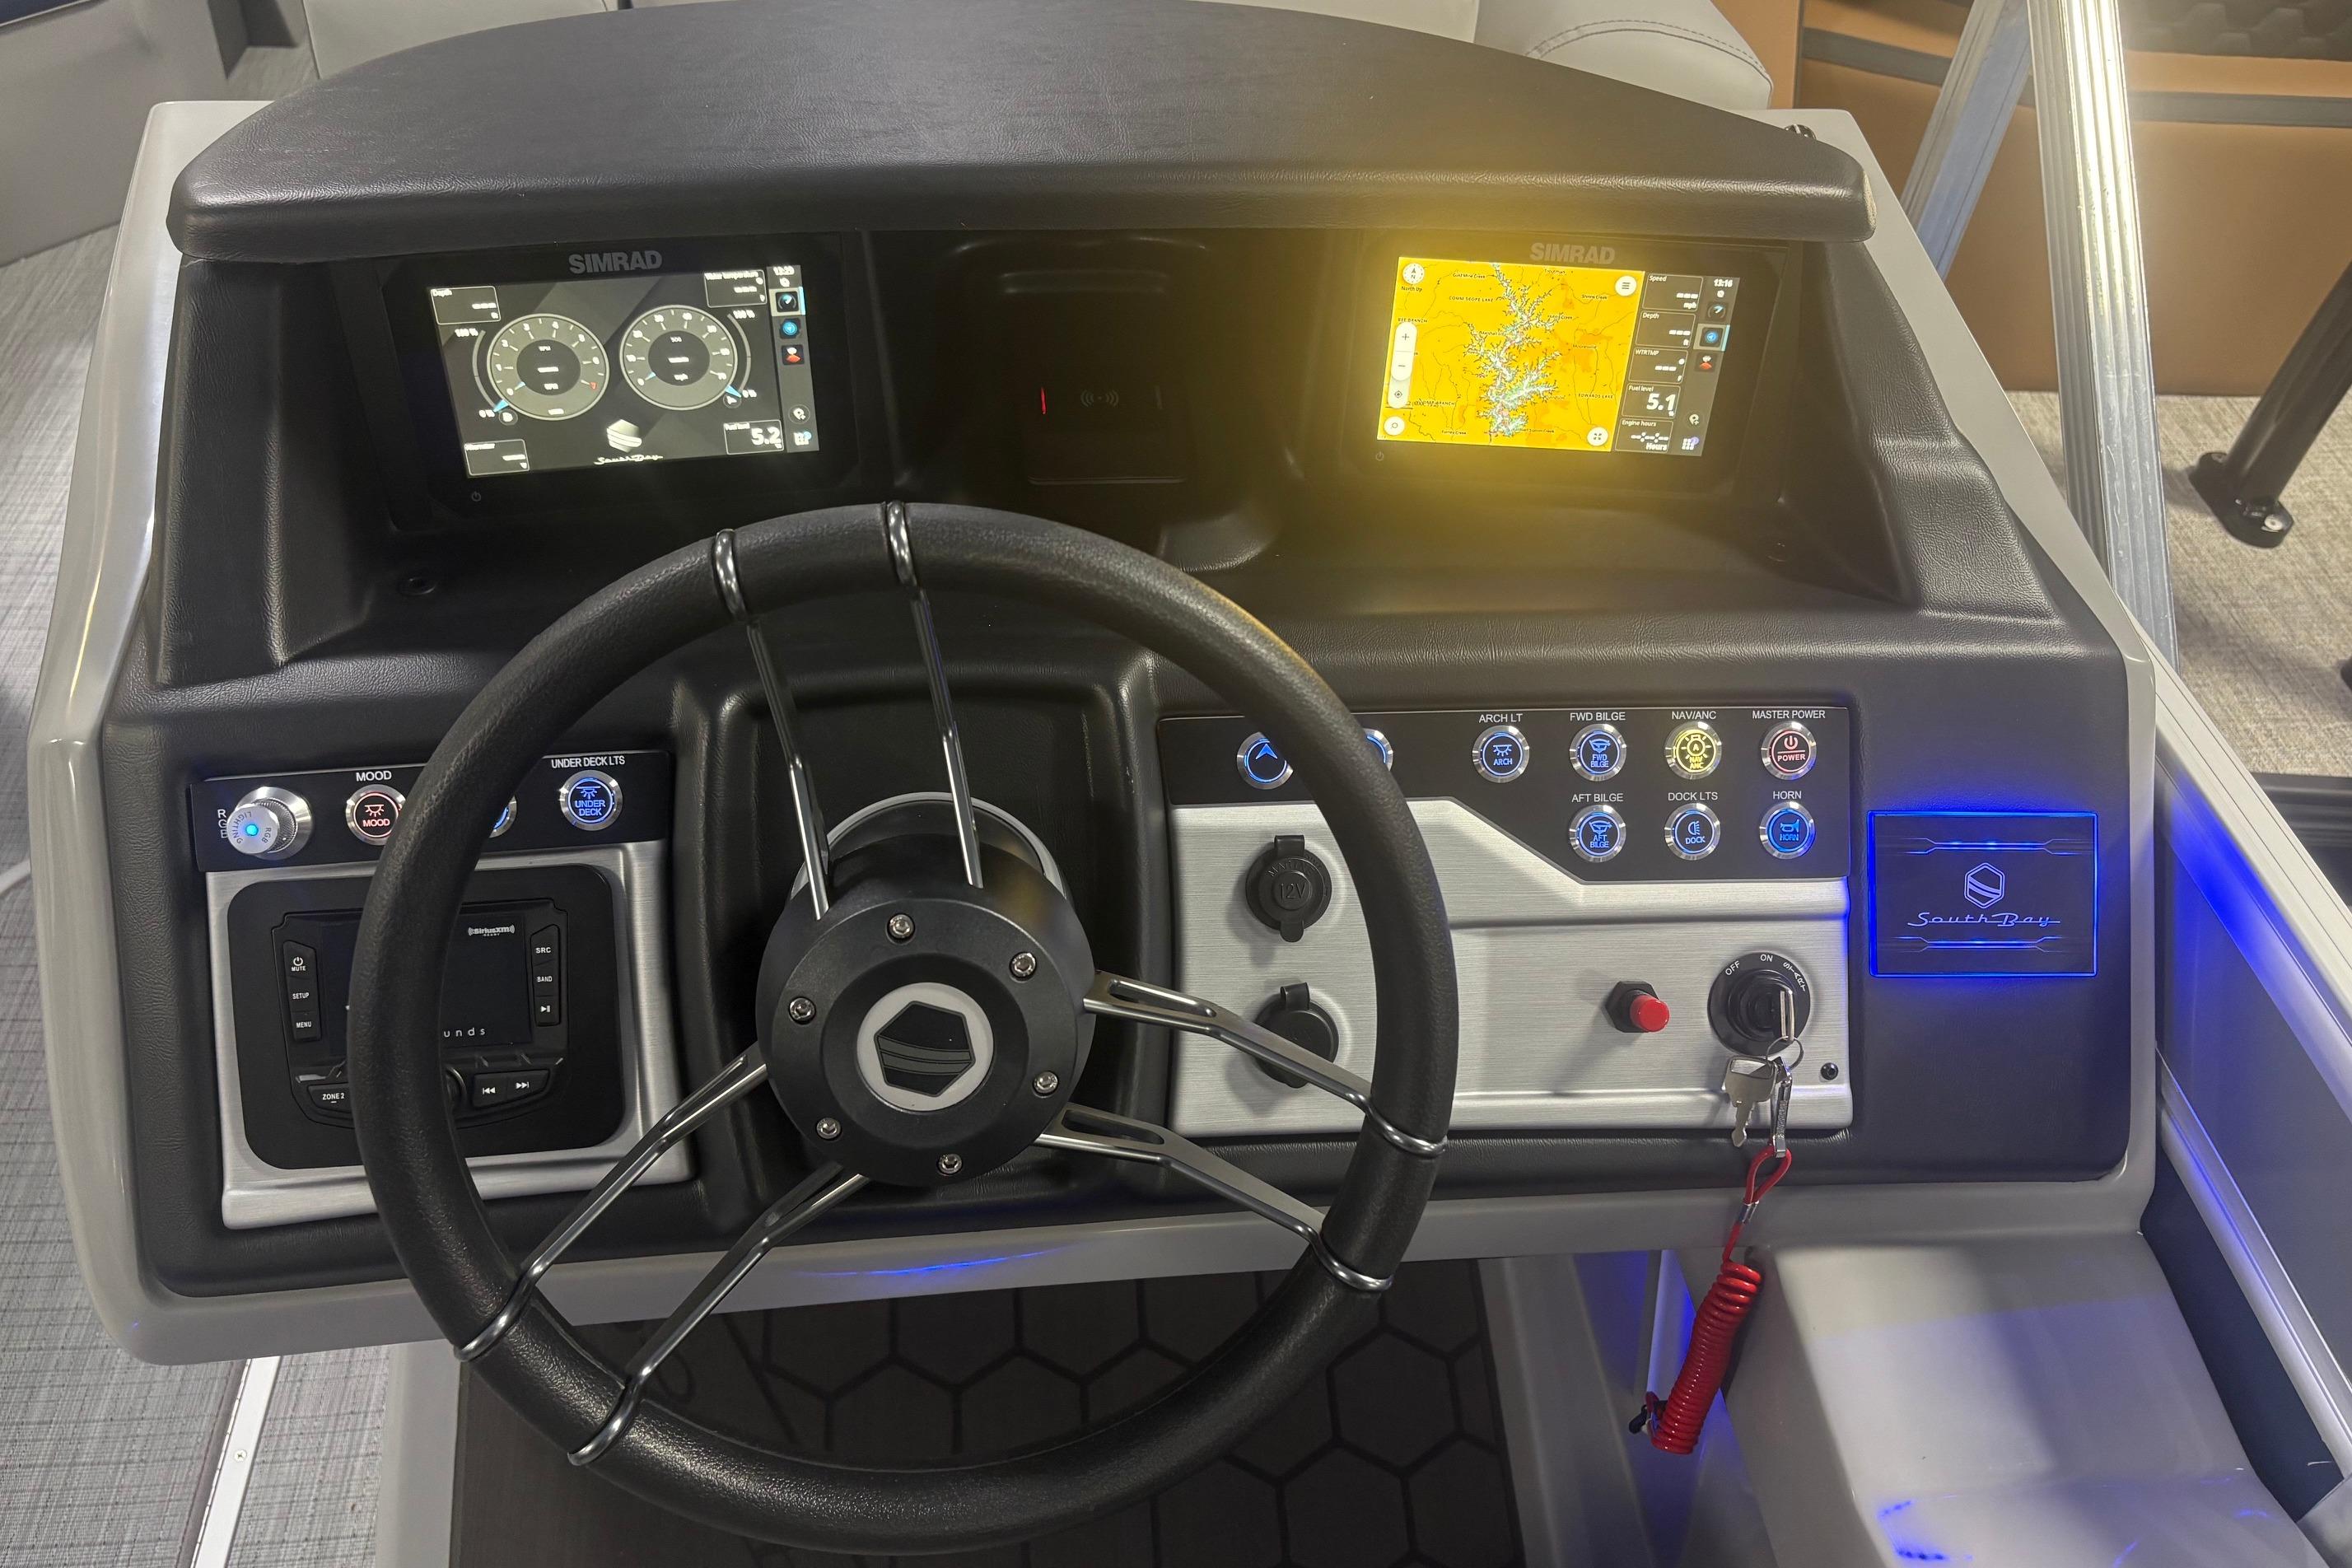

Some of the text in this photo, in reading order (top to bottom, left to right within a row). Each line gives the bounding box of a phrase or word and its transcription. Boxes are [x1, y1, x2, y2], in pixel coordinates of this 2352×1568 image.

[1529, 242, 1615, 264] SIMRAD
[568, 250, 663, 274] SIMRAD
[1646, 393, 1676, 411] 5.1
[751, 427, 782, 446] 5.2
[1646, 442, 1668, 450] Hours
[1479, 713, 1523, 723] ARCH LT
[1570, 712, 1626, 721] FWD BILGE
[1671, 711, 1716, 720] NAV/ANC
[1752, 710, 1826, 719] MASTER POWER
[551, 755, 626, 768] UNDER DECK LTS
[1493, 758, 1513, 766] ARCH
[1592, 754, 1608, 762] FWD
[356, 770, 392, 782] MOOD
[1571, 793, 1624, 803] AFT BILGE
[1668, 791, 1719, 801] DOCK LTS
[1772, 791, 1802, 800] HORN
[575, 800, 606, 808] UNDER
[579, 808, 602, 817] DECK
[231, 811, 252, 844] LIGHTING
[362, 819, 390, 828] MOOD
[262, 827, 272, 843] RGB
[1780, 833, 1799, 842] HORN
[1685, 836, 1706, 845] DOCK
[1281, 883, 1307, 899] 12V
[1907, 912, 2060, 927] South Bay
[1760, 954, 1773, 963] ON
[1724, 960, 1740, 976] OFF
[1783, 962, 1806, 992] START
[292, 992, 310, 1000] SETUP
[296, 1020, 312, 1029] MENU
[443, 1027, 486, 1038] unds
